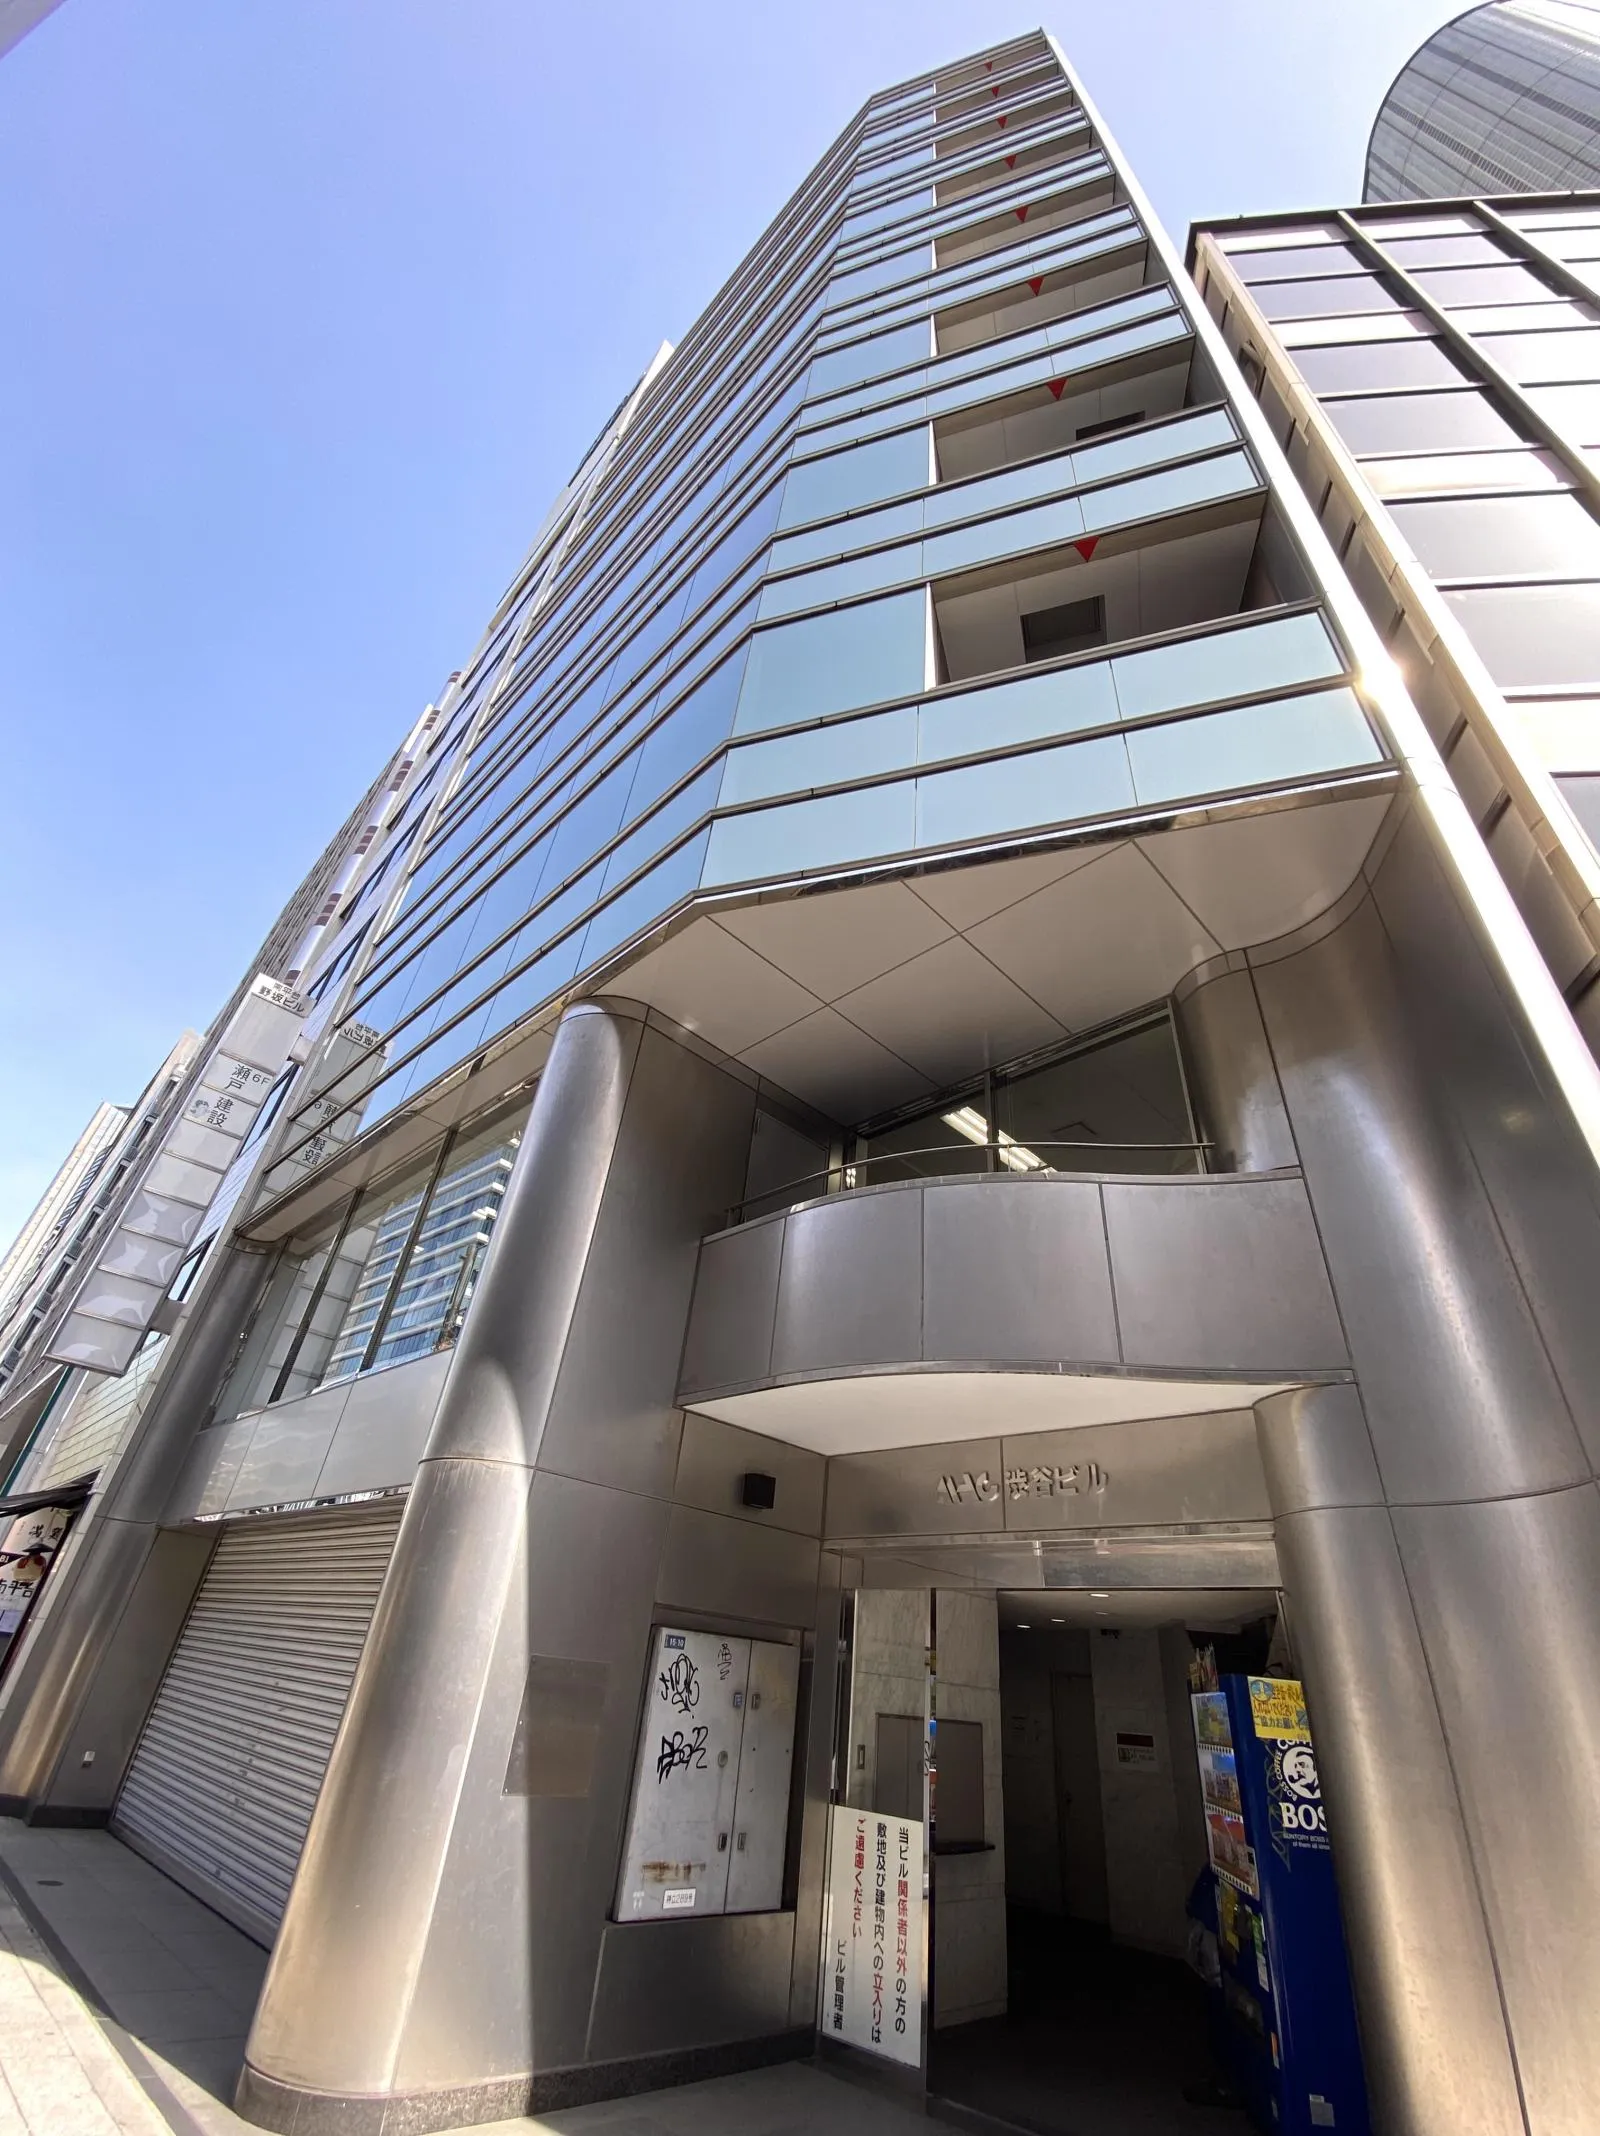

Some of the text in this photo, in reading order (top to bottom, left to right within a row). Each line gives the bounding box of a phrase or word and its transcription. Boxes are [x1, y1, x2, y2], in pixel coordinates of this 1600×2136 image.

[260, 985, 304, 1012] 野坂ビル
[252, 1073, 270, 1085] 6F
[207, 1096, 234, 1128] 建設
[1005, 1463, 1109, 1500] 渋谷ビル
[1279, 1801, 1328, 1832] BOS
[852, 1818, 866, 1938] ご遠慮ください
[871, 1822, 887, 2044] 敷地及び建物内への立入りは
[895, 1826, 909, 2035] 当ビル関係者以外の方の
[833, 1939, 847, 2031] ビル管理者
